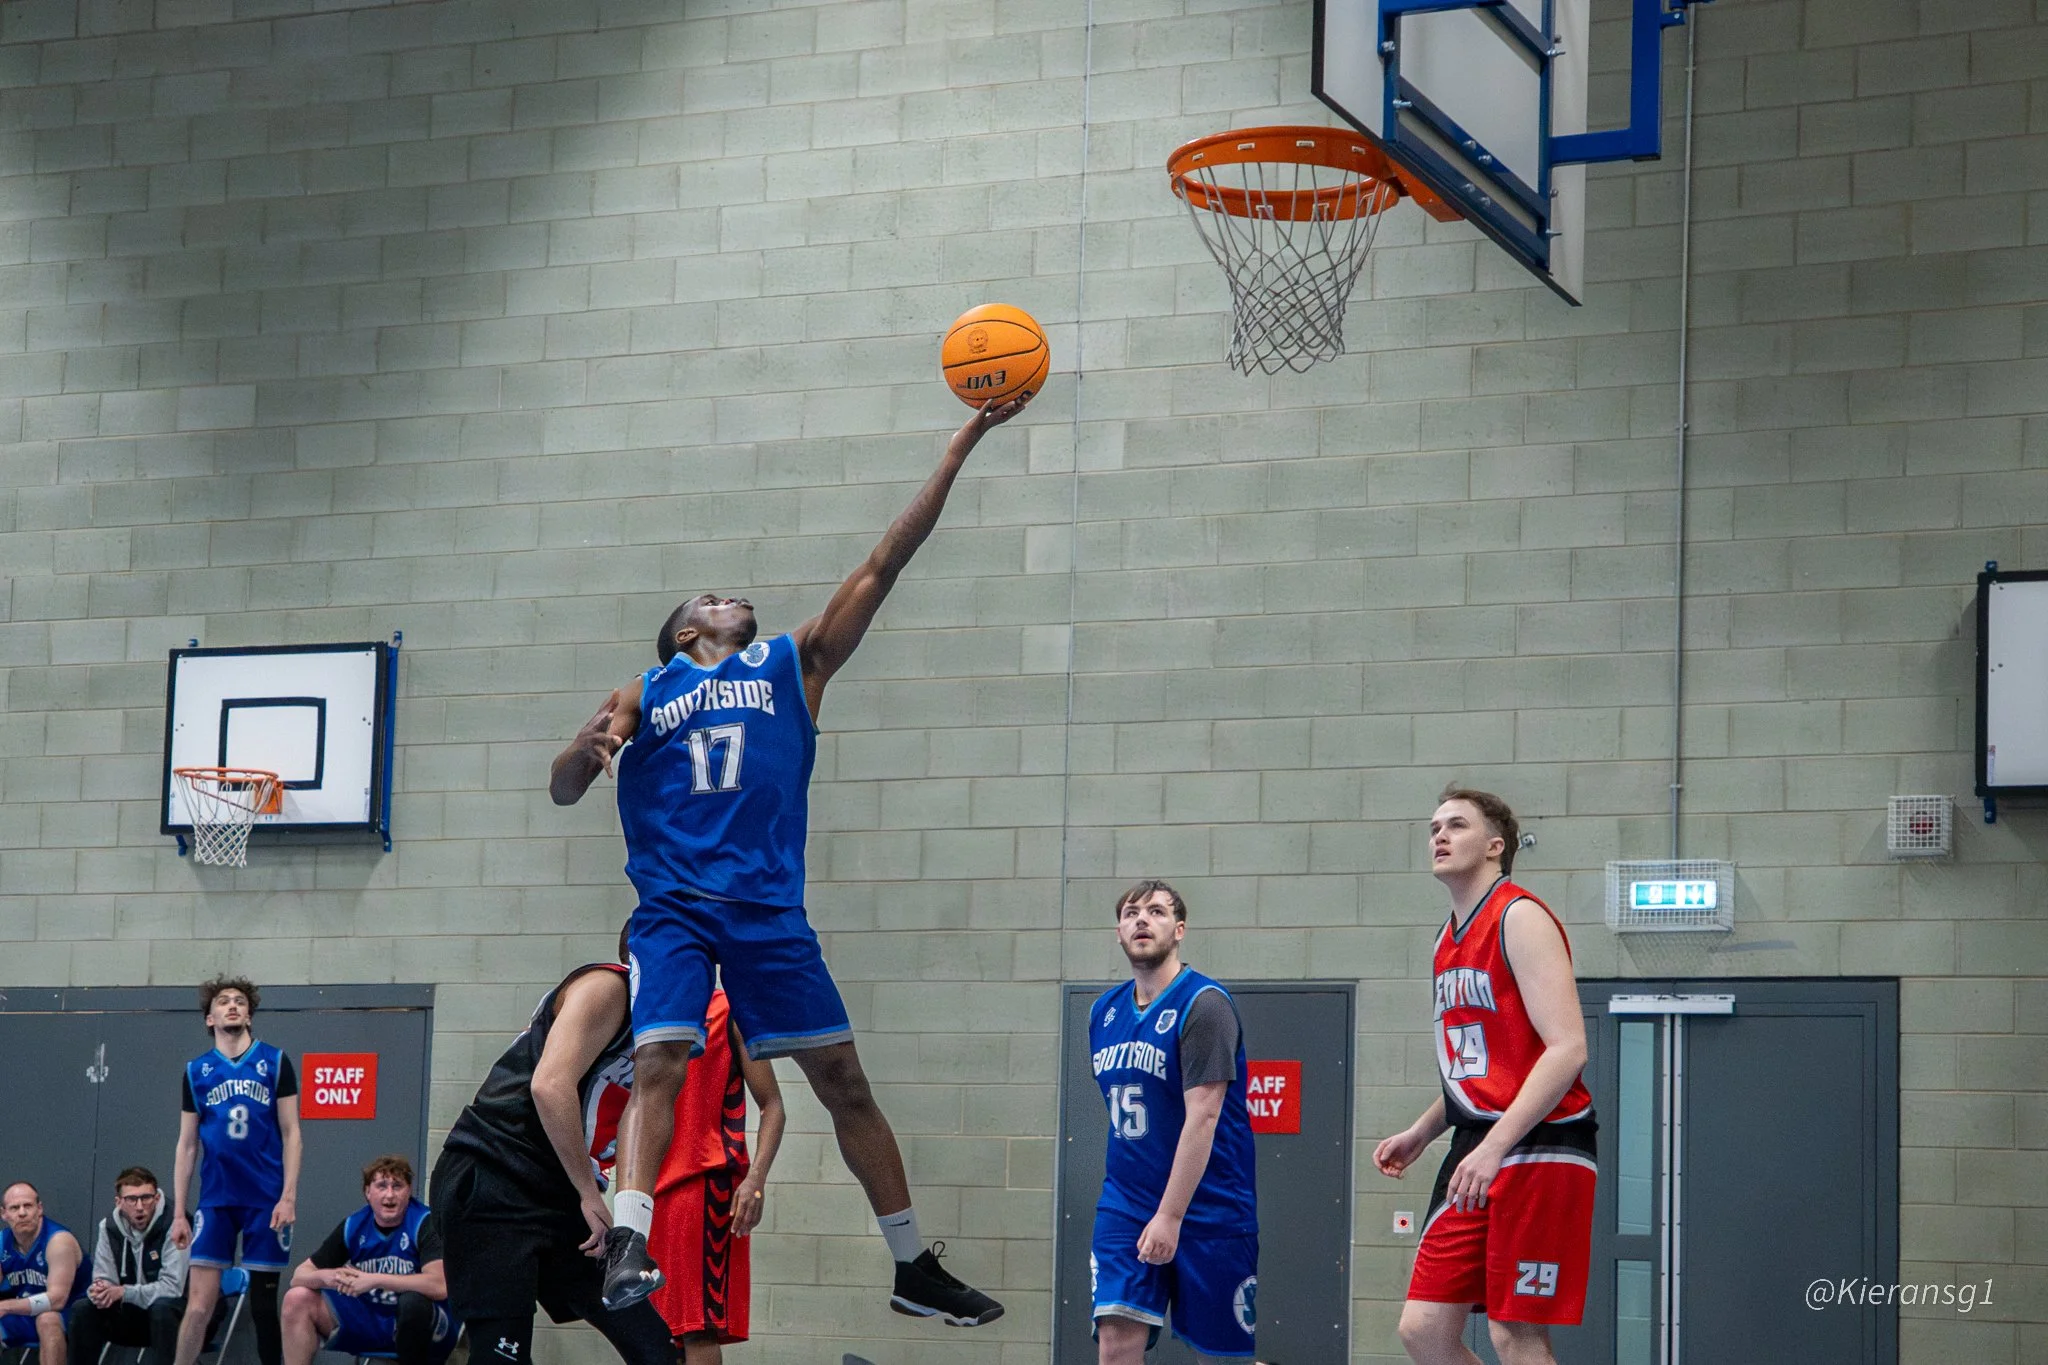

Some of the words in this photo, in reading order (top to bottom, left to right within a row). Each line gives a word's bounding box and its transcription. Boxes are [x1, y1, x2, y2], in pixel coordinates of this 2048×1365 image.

[966, 370, 1007, 390] EVO
[651, 679, 775, 737] SOUTHSIDE
[683, 722, 745, 795] 17
[1434, 967, 1497, 1021] ENTON
[314, 1067, 365, 1085] STAFF
[1248, 1076, 1286, 1095] AFF
[206, 1079, 271, 1107] SOUTHSIDE
[315, 1088, 362, 1106] ONLY
[1245, 1098, 1283, 1117] NLY
[227, 1104, 249, 1140] 8
[1107, 1083, 1149, 1140] 15
[1514, 1260, 1560, 1298] 29
